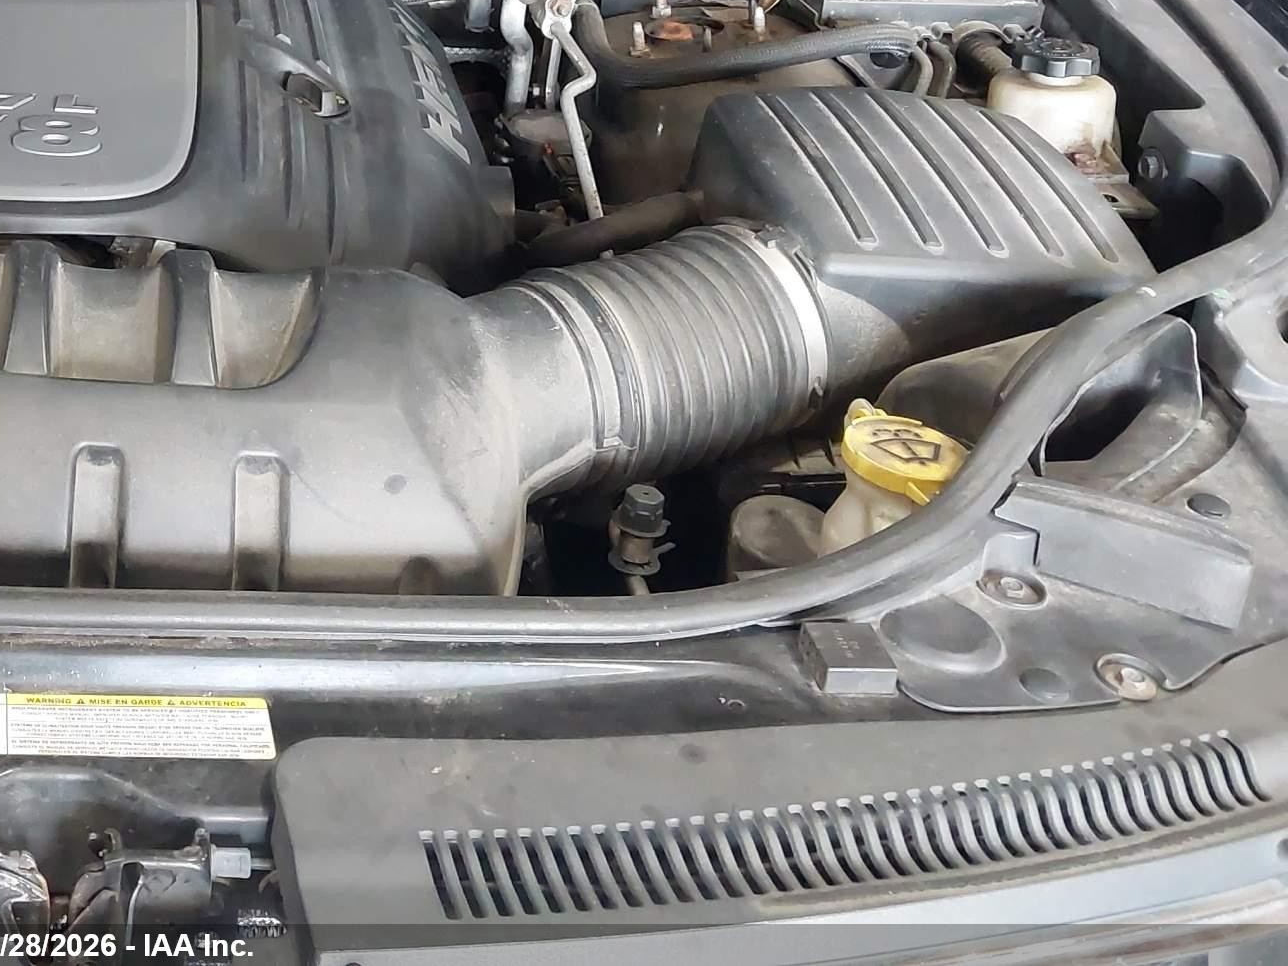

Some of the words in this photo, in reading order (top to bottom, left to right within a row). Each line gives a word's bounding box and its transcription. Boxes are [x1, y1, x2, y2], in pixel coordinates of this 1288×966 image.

[53, 93, 99, 115] L
[25, 697, 72, 705] WARNING
[115, 698, 129, 706] EN
[179, 699, 247, 707] ADVERTENCIA
